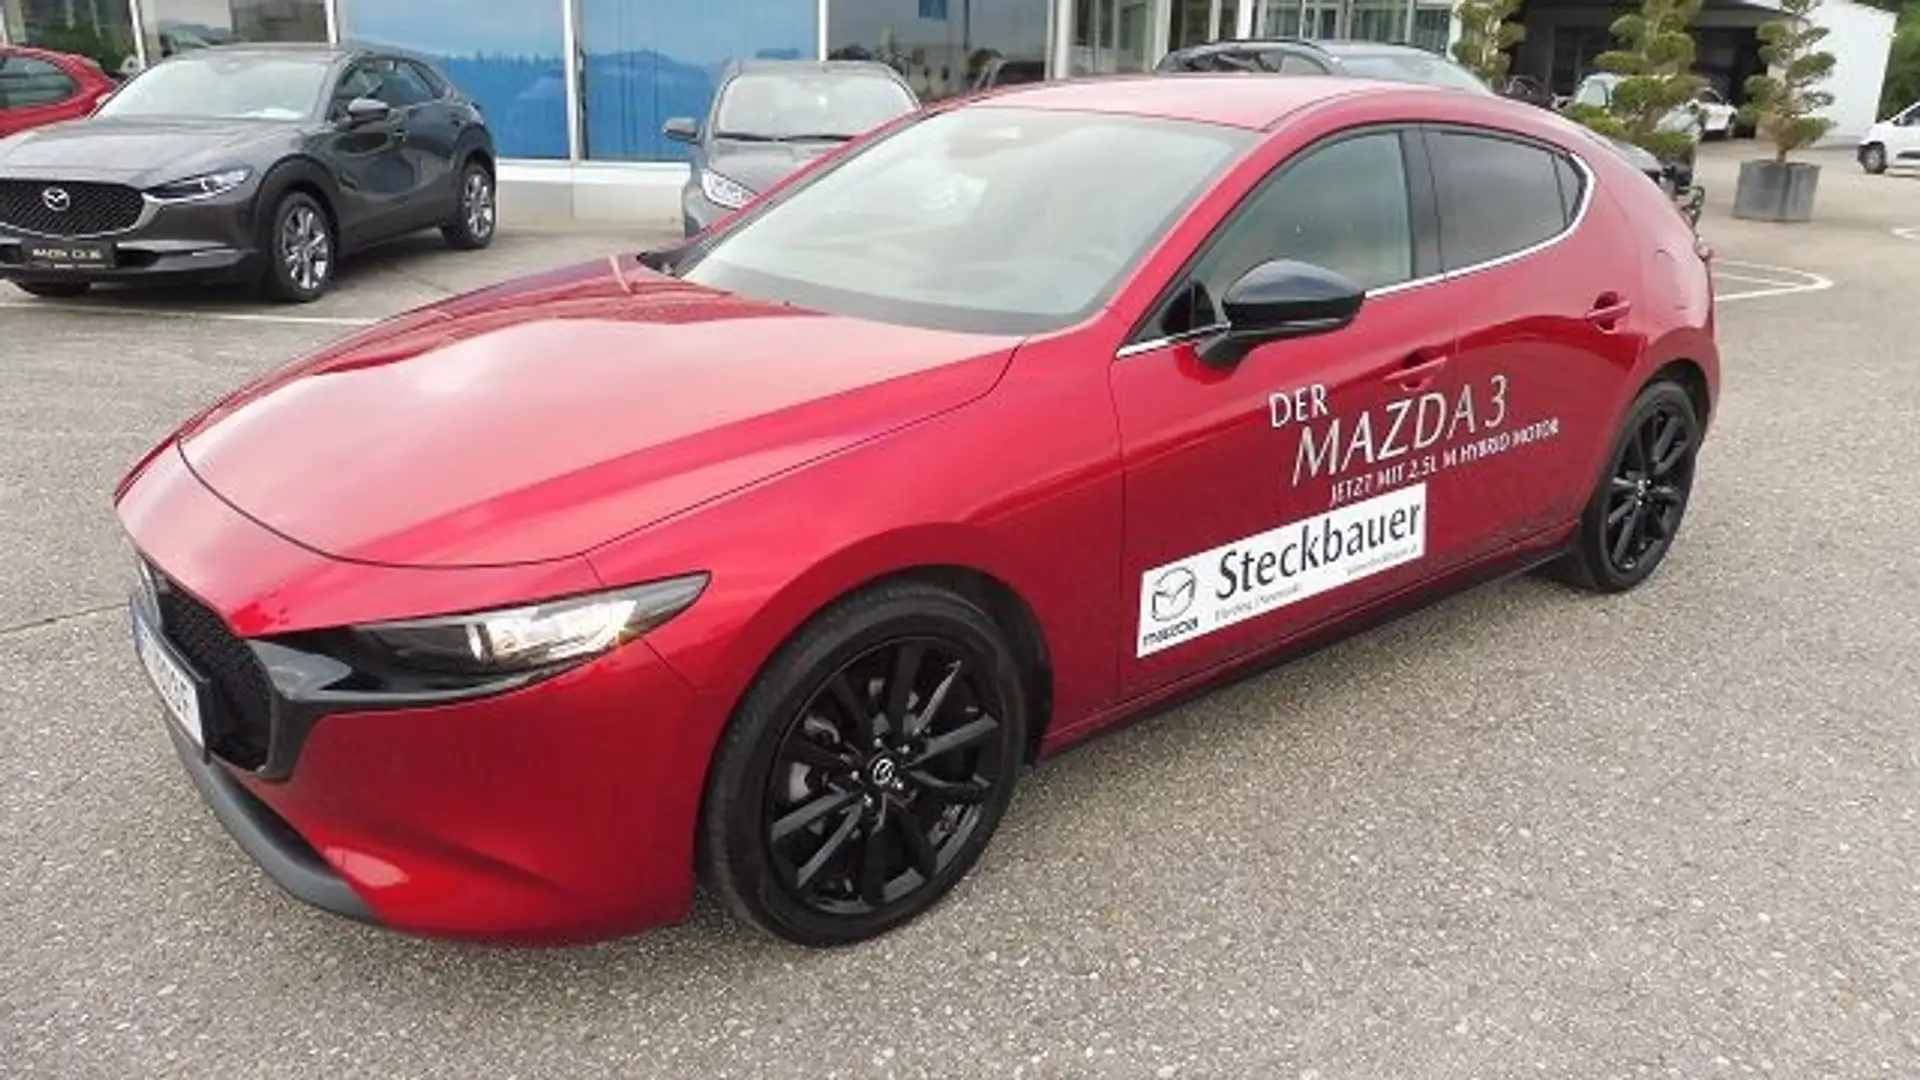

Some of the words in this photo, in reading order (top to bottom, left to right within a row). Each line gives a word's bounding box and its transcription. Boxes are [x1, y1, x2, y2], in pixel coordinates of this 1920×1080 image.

[1268, 384, 1329, 428] DER
[1292, 384, 1477, 487] MAZDA
[1484, 373, 1507, 428] 3
[1377, 463, 1404, 489] MIT
[1460, 431, 1510, 463] HYBRID
[1511, 417, 1560, 446] MOTOR
[1216, 503, 1421, 600] Steckbauer
